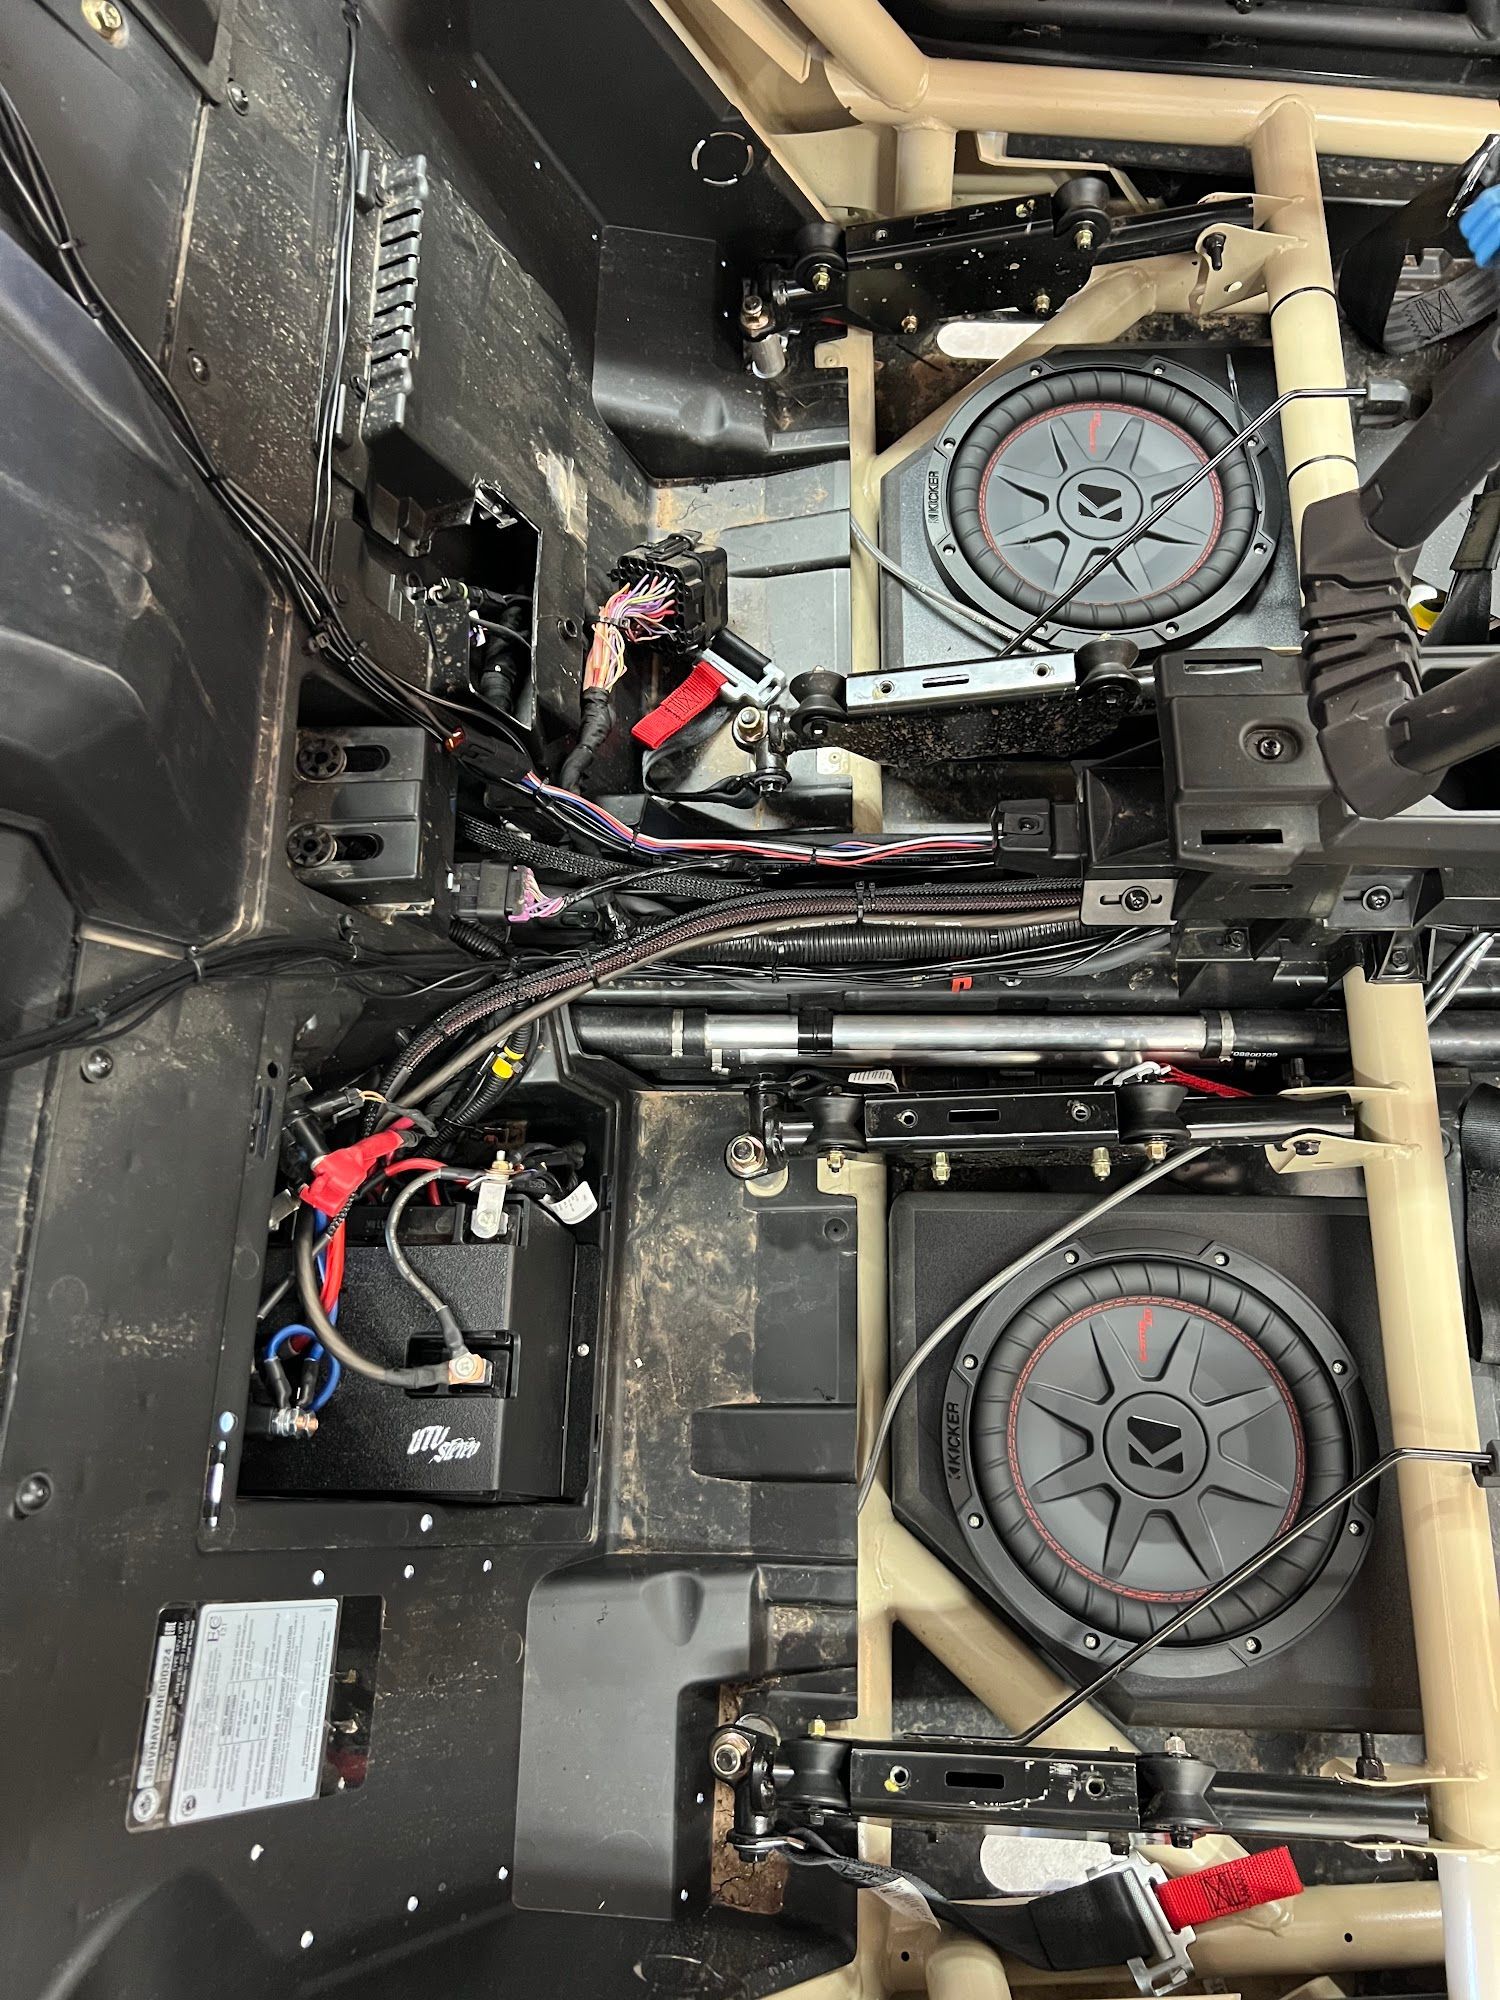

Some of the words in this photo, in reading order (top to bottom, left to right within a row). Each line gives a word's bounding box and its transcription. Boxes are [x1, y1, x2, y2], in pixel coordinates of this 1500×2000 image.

[928, 470, 940, 514] KICKER
[406, 1424, 451, 1455] UTV
[946, 1401, 960, 1466] KICKER
